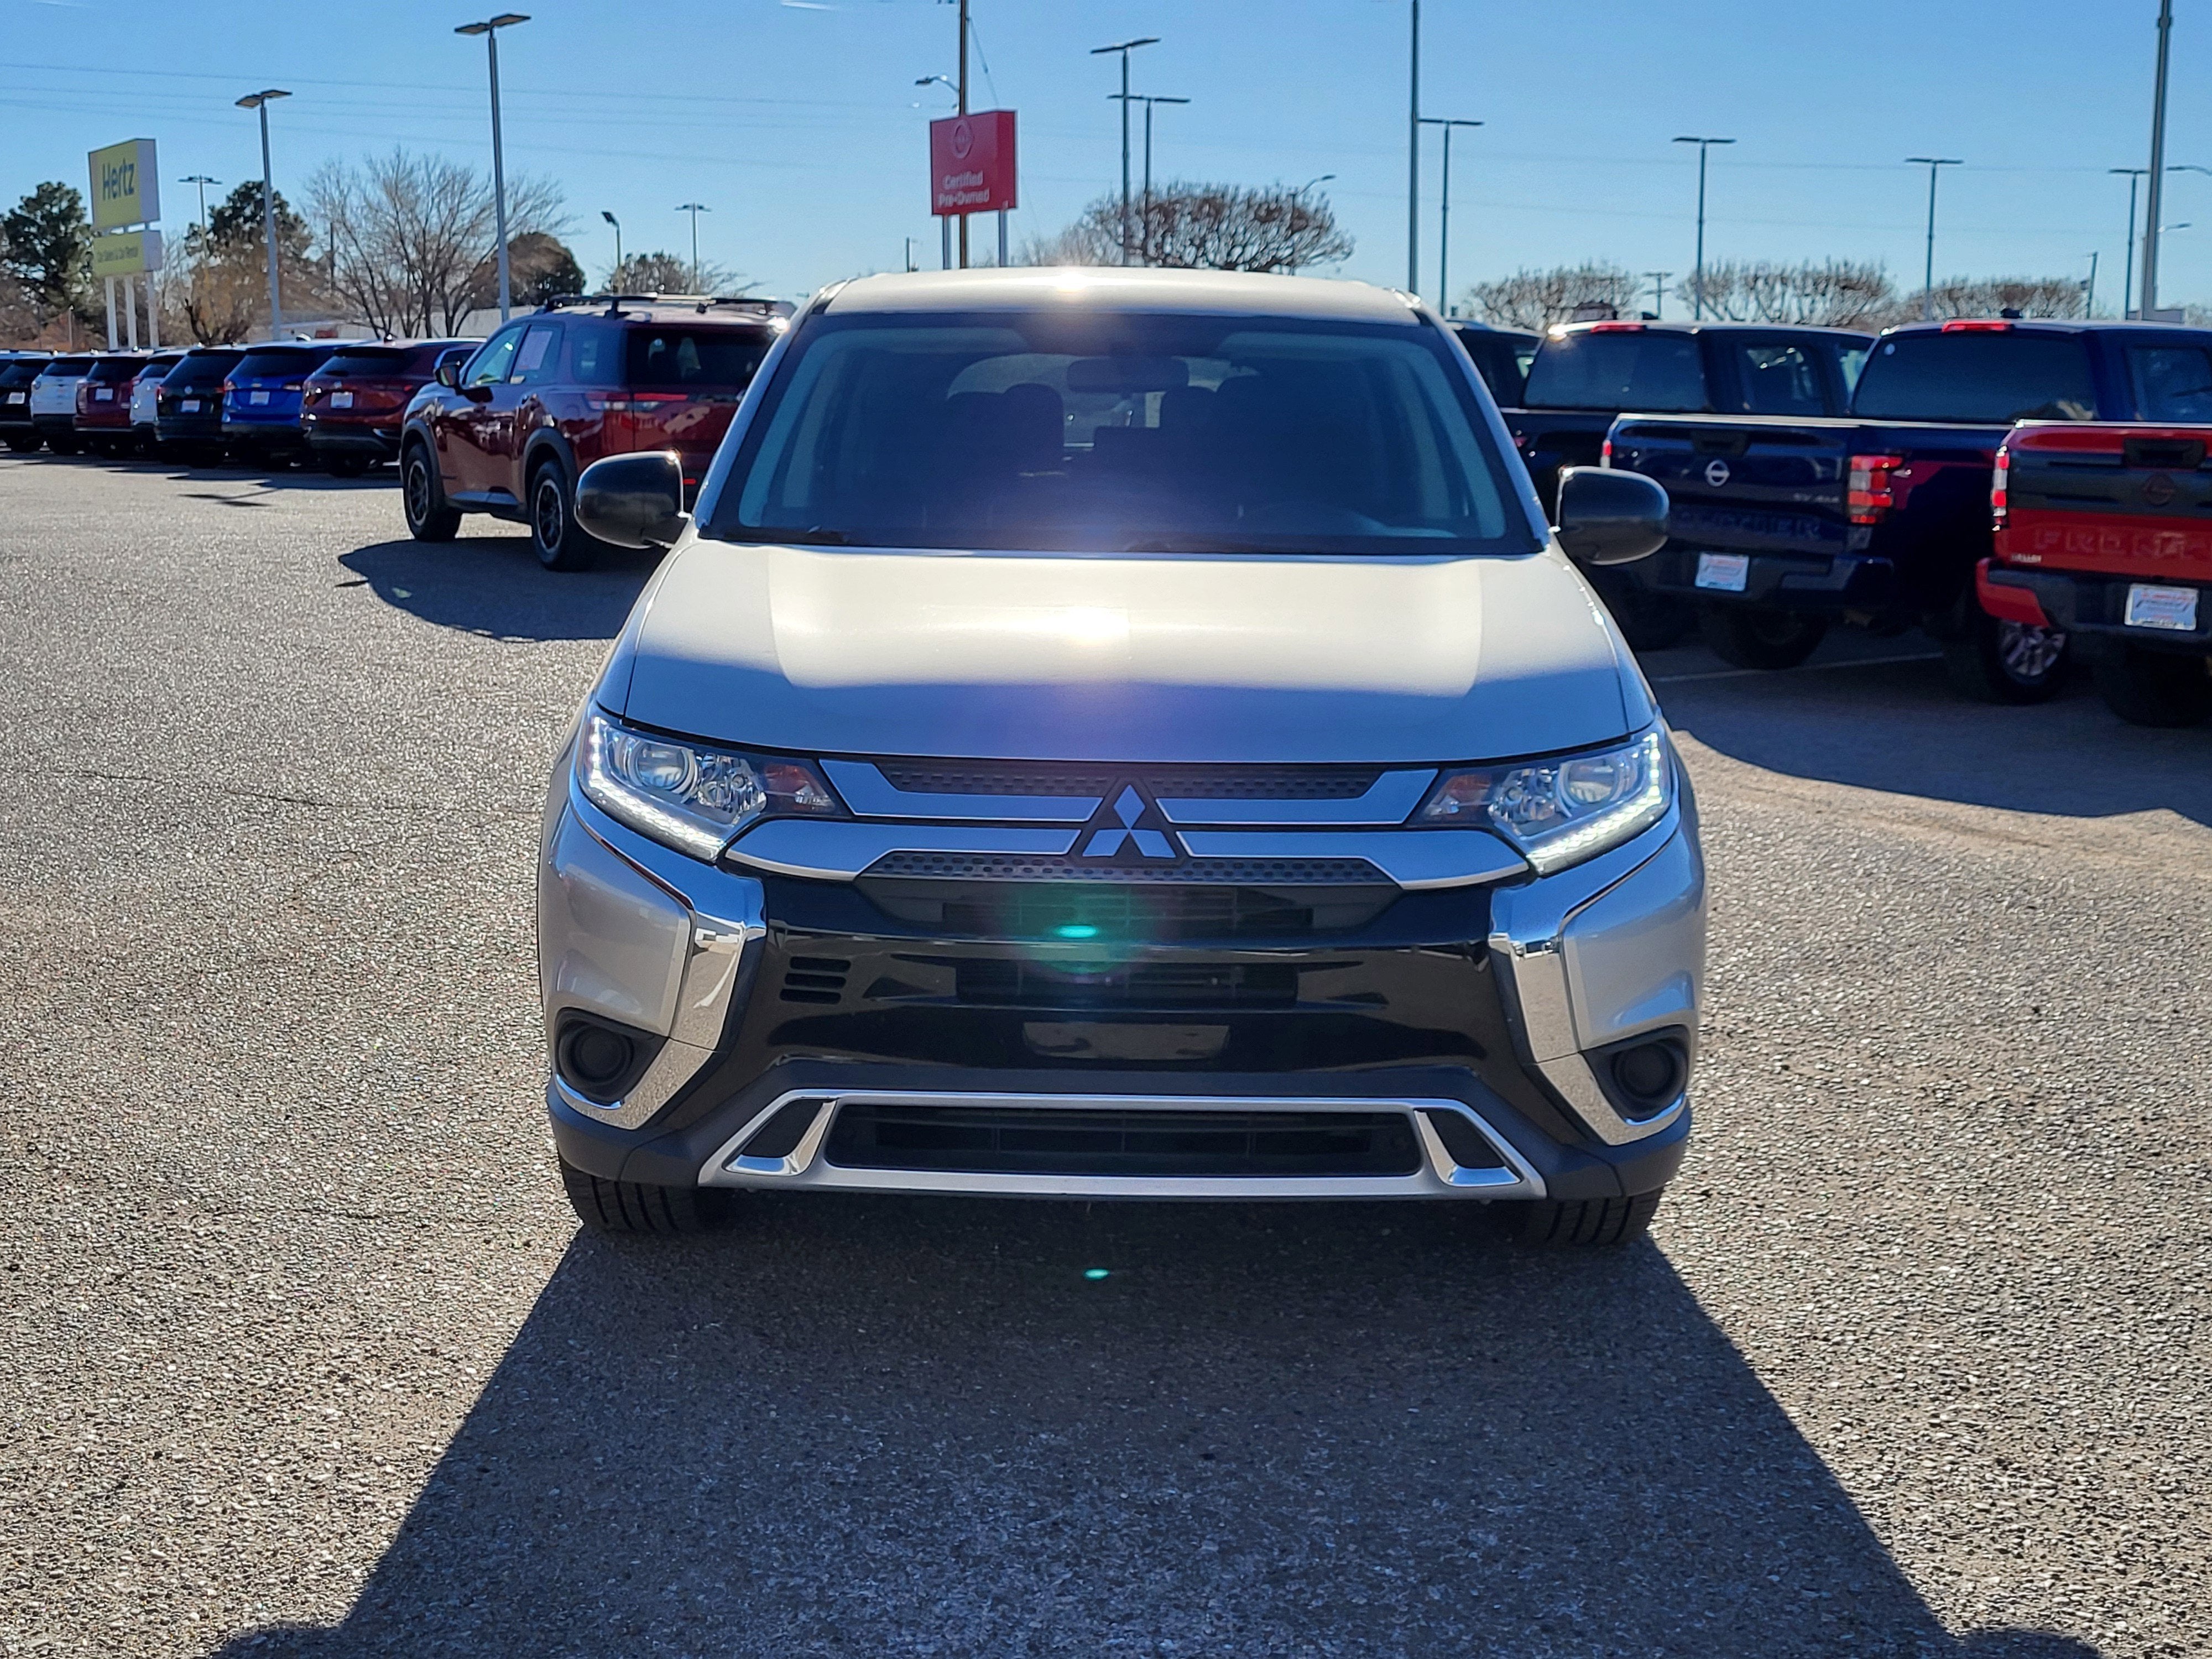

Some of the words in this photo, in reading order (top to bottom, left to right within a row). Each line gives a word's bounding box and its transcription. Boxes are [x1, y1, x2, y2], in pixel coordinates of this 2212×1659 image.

[102, 158, 134, 200] Hertz
[943, 171, 983, 189] Certified
[938, 188, 989, 207] Pre-Owned
